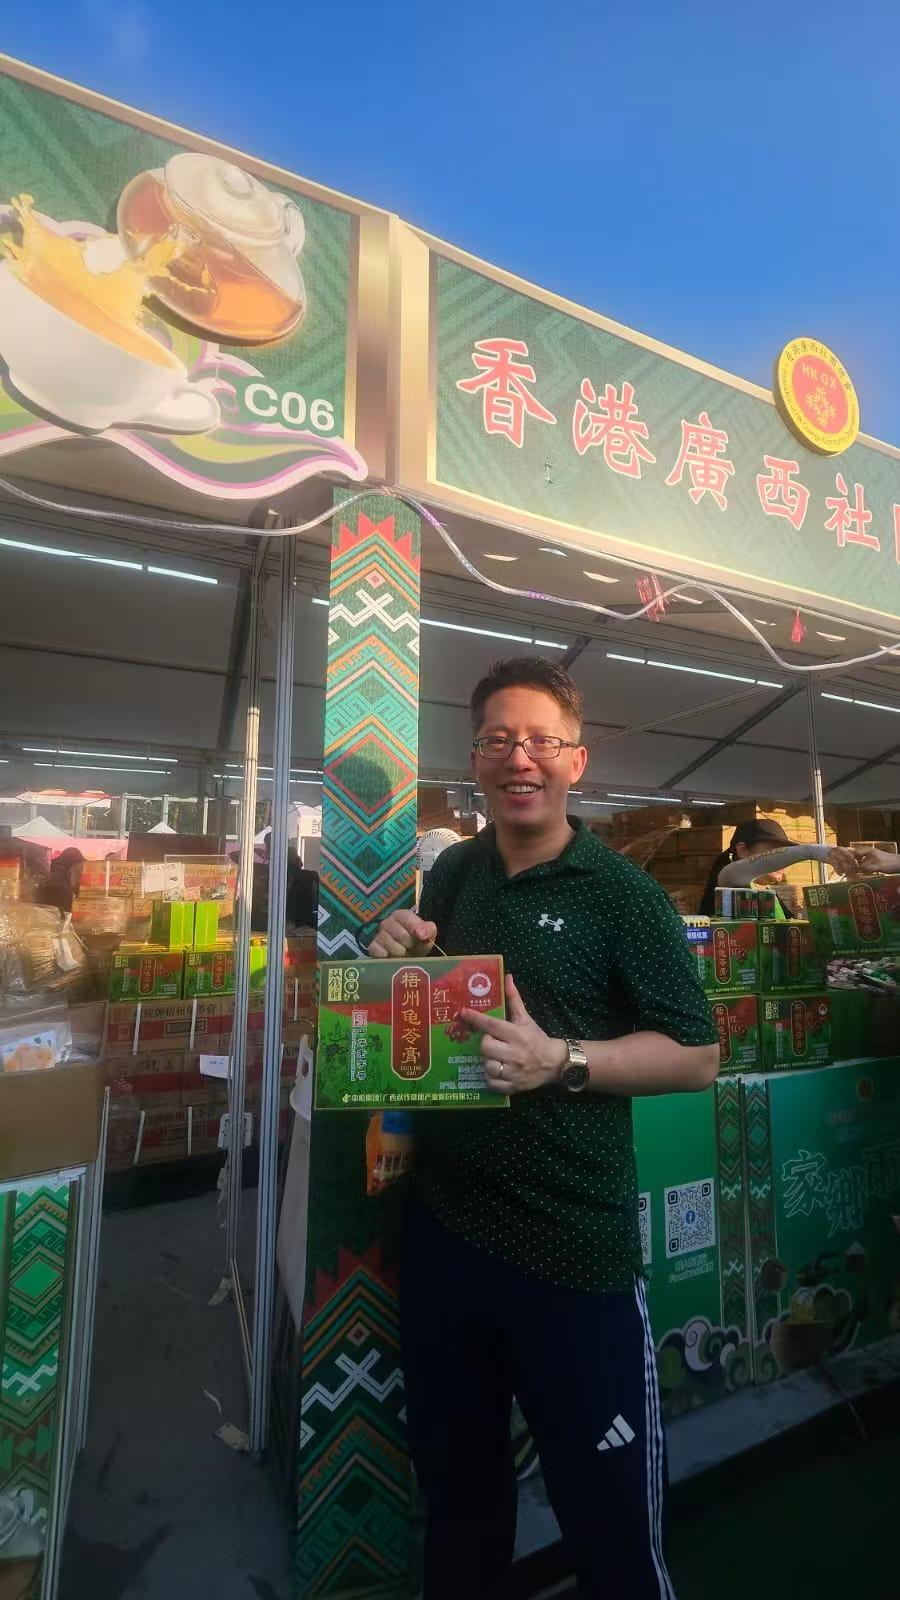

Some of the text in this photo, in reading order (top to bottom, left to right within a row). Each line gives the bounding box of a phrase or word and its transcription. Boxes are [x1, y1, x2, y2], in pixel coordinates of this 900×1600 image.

[801, 362, 818, 380] HK
[244, 383, 335, 431] C06
[456, 337, 900, 565] 香港廣西社
[401, 972, 422, 1064] 梧州龟苓膏
[432, 987, 452, 1023] 红豆
